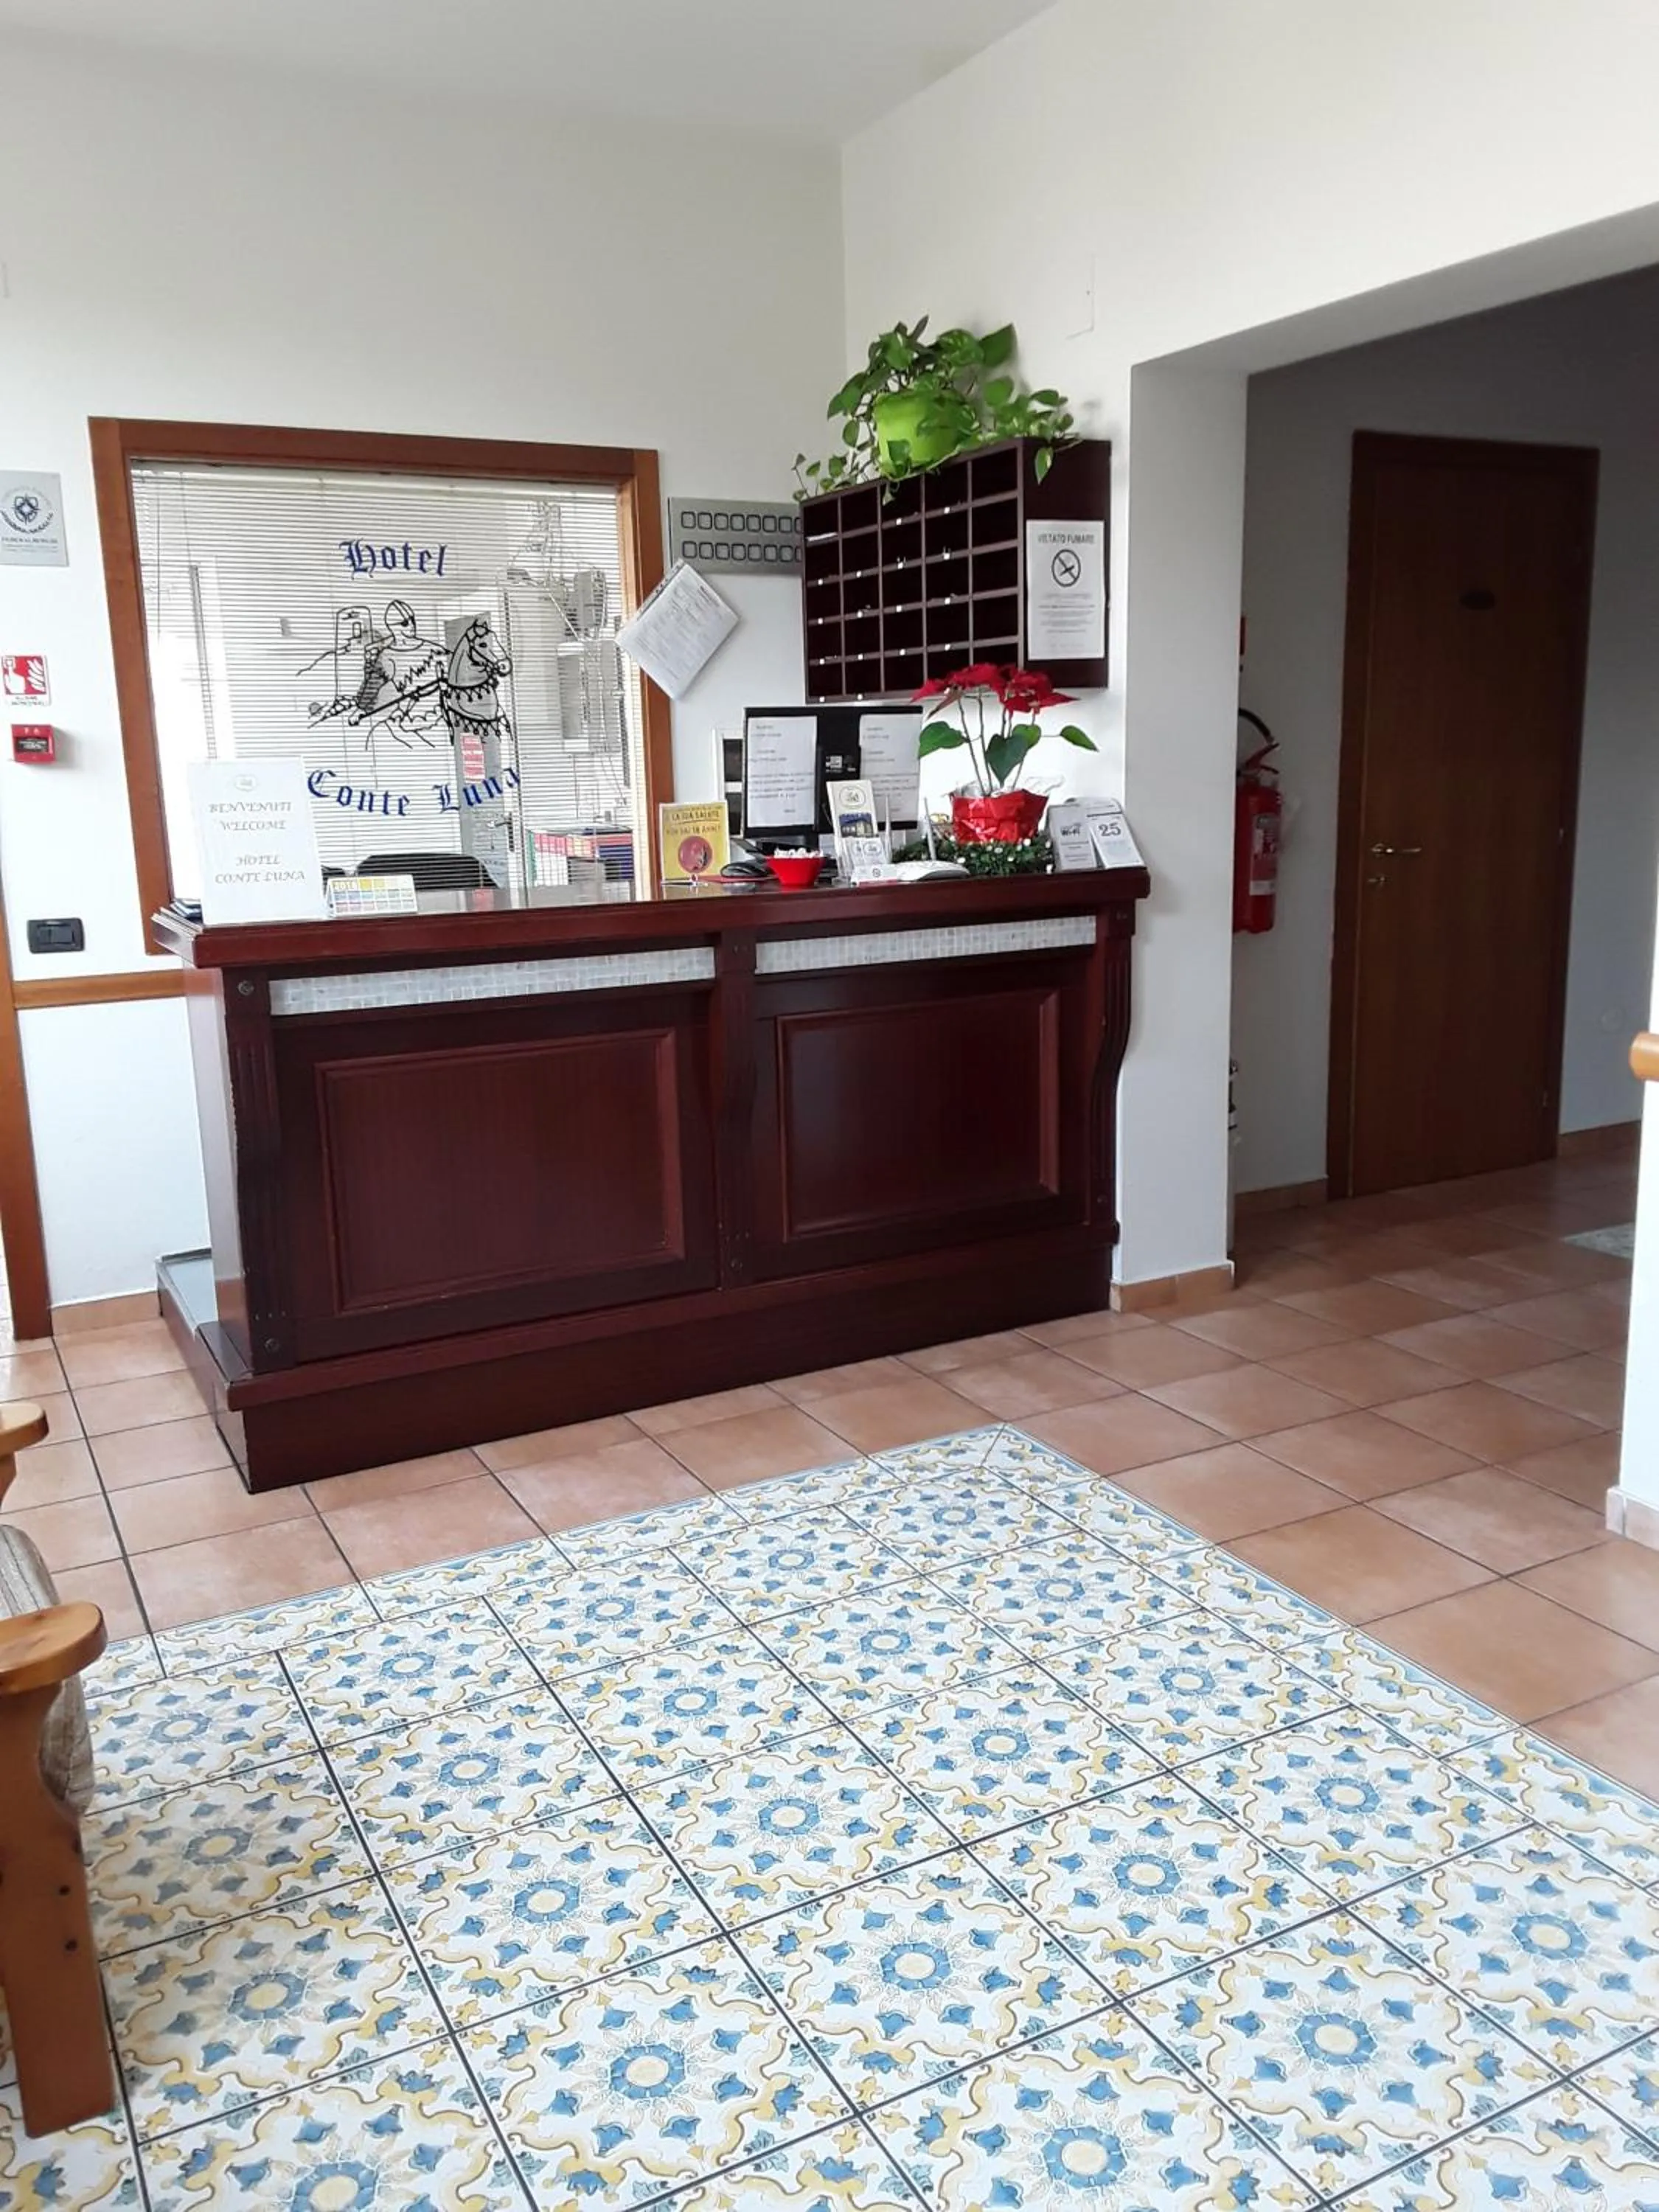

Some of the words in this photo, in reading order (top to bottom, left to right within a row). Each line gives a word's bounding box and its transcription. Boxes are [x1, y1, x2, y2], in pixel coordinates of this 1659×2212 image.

[1037, 533, 1065, 544] VIETATO
[1067, 533, 1095, 544] FUMARE
[338, 538, 448, 580] Hotel
[307, 768, 410, 816] Conte
[432, 767, 520, 813] Luna
[209, 801, 292, 813] BENVENUTI
[220, 820, 286, 831] WELCOME
[1099, 822, 1121, 837] 25
[236, 855, 281, 866] HOTEL
[215, 872, 261, 884] CONTE
[262, 871, 305, 882] LUNA
